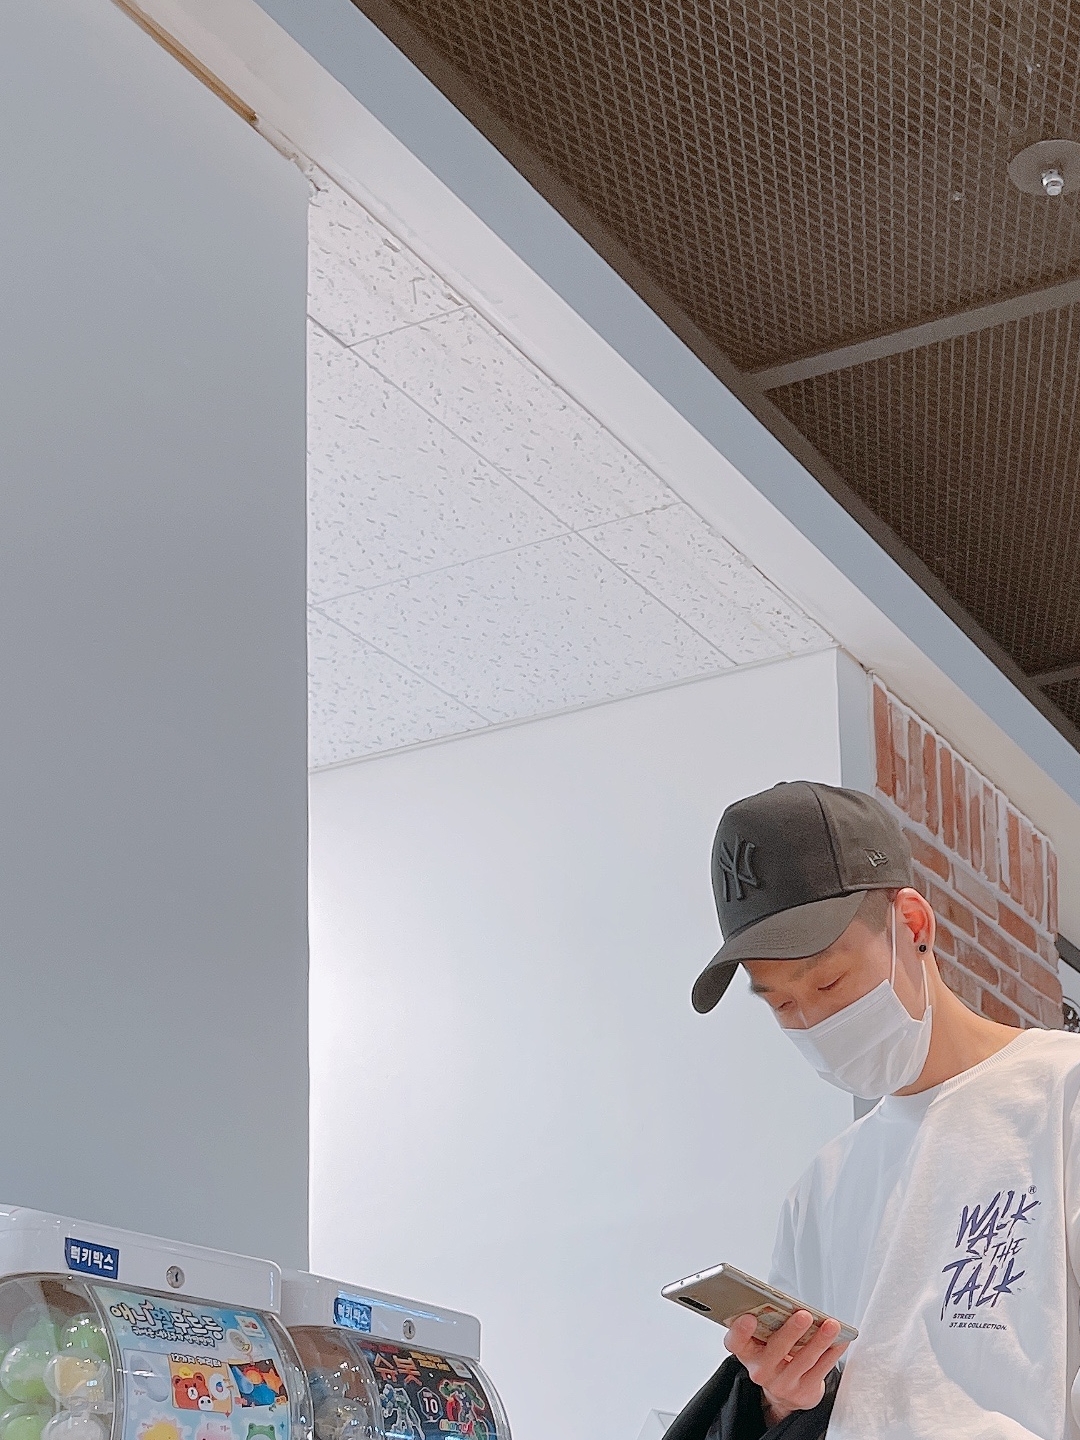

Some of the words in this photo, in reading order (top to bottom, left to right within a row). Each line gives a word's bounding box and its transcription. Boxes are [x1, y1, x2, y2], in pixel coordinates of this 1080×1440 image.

[955, 1190, 1041, 1252] WALK
[70, 1245, 114, 1271] 럭키박스
[989, 1237, 1027, 1267] THE
[941, 1257, 1026, 1321] TALK
[422, 1397, 438, 1414] 10
